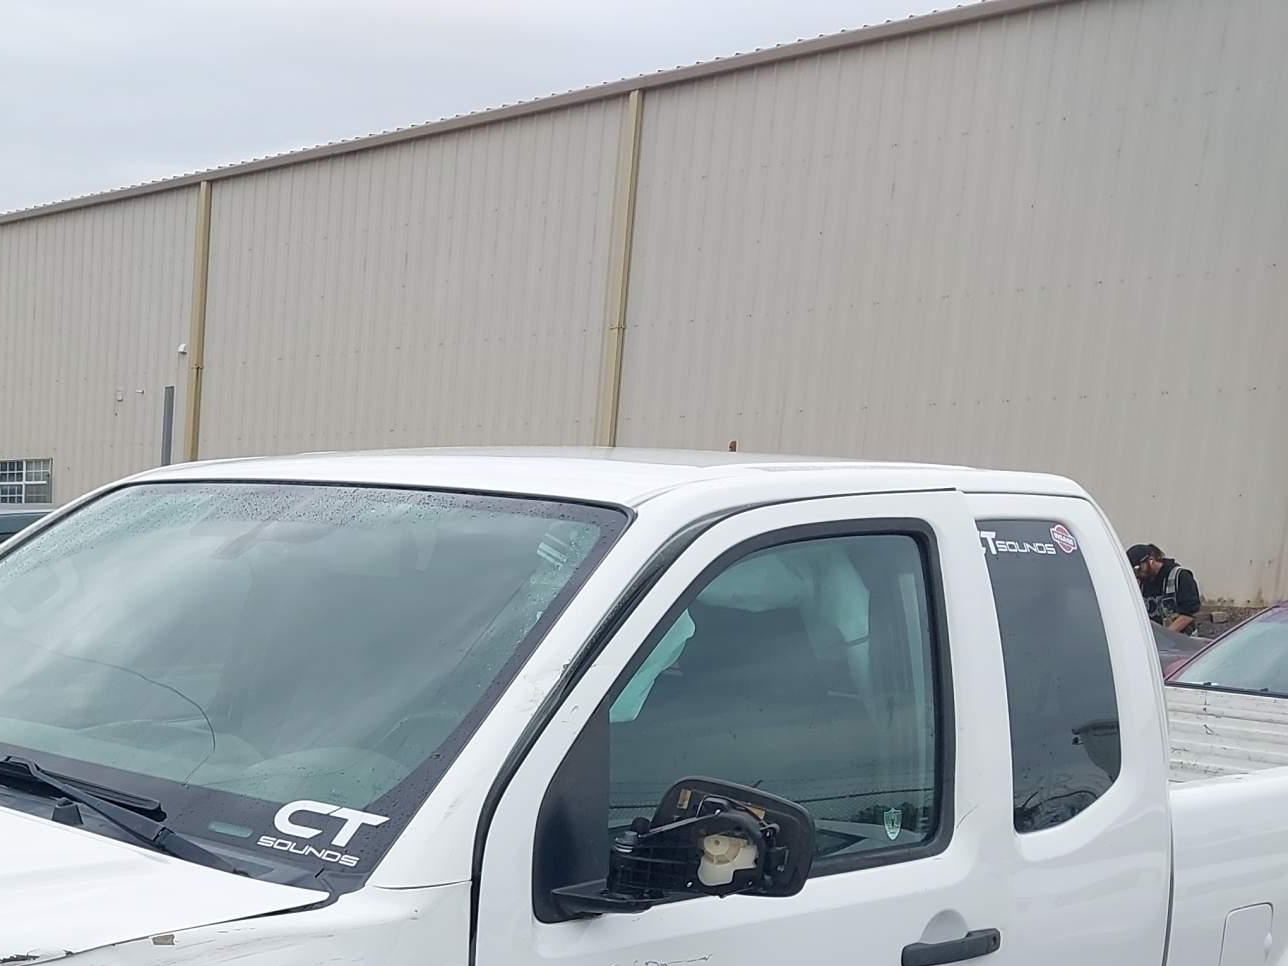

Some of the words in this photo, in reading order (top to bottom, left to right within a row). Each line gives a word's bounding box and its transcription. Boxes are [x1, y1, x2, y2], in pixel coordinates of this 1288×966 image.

[978, 531, 997, 555] T
[995, 540, 1057, 555] SOUNDS
[274, 800, 390, 848] CT
[256, 835, 361, 868] SOUNDS
